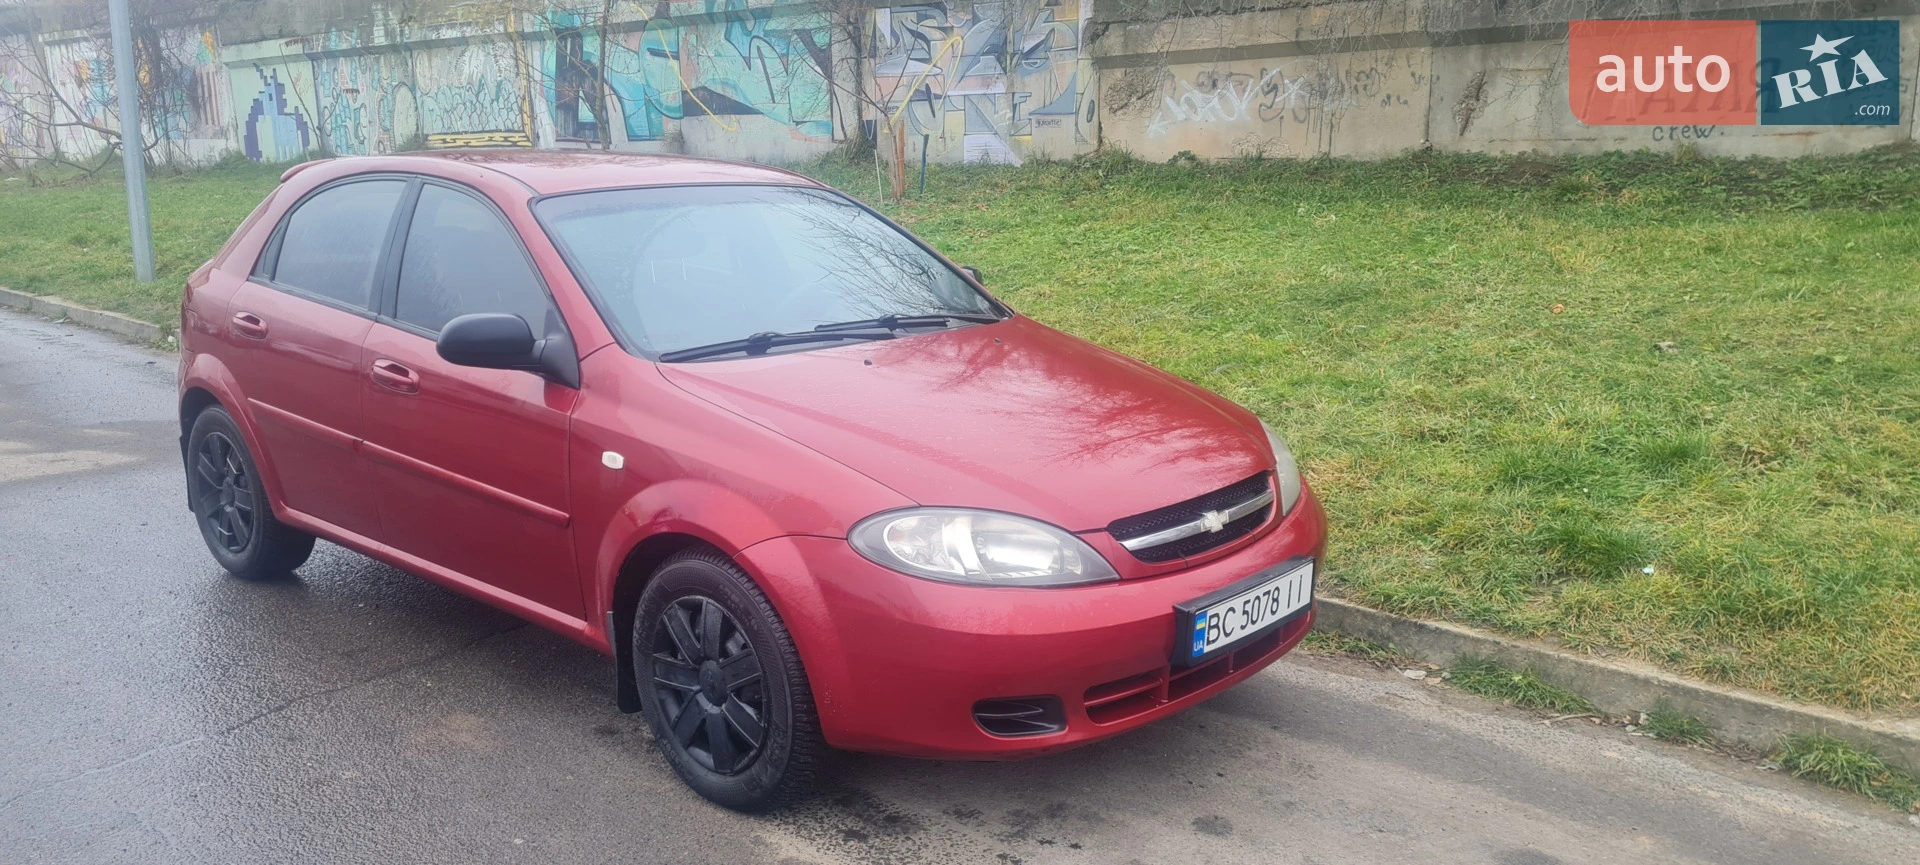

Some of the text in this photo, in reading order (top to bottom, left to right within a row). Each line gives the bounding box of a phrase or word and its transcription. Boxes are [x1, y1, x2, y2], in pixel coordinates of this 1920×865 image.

[1206, 606, 1236, 646] BC
[1240, 586, 1281, 631] 5078
[1193, 640, 1204, 653] UA
